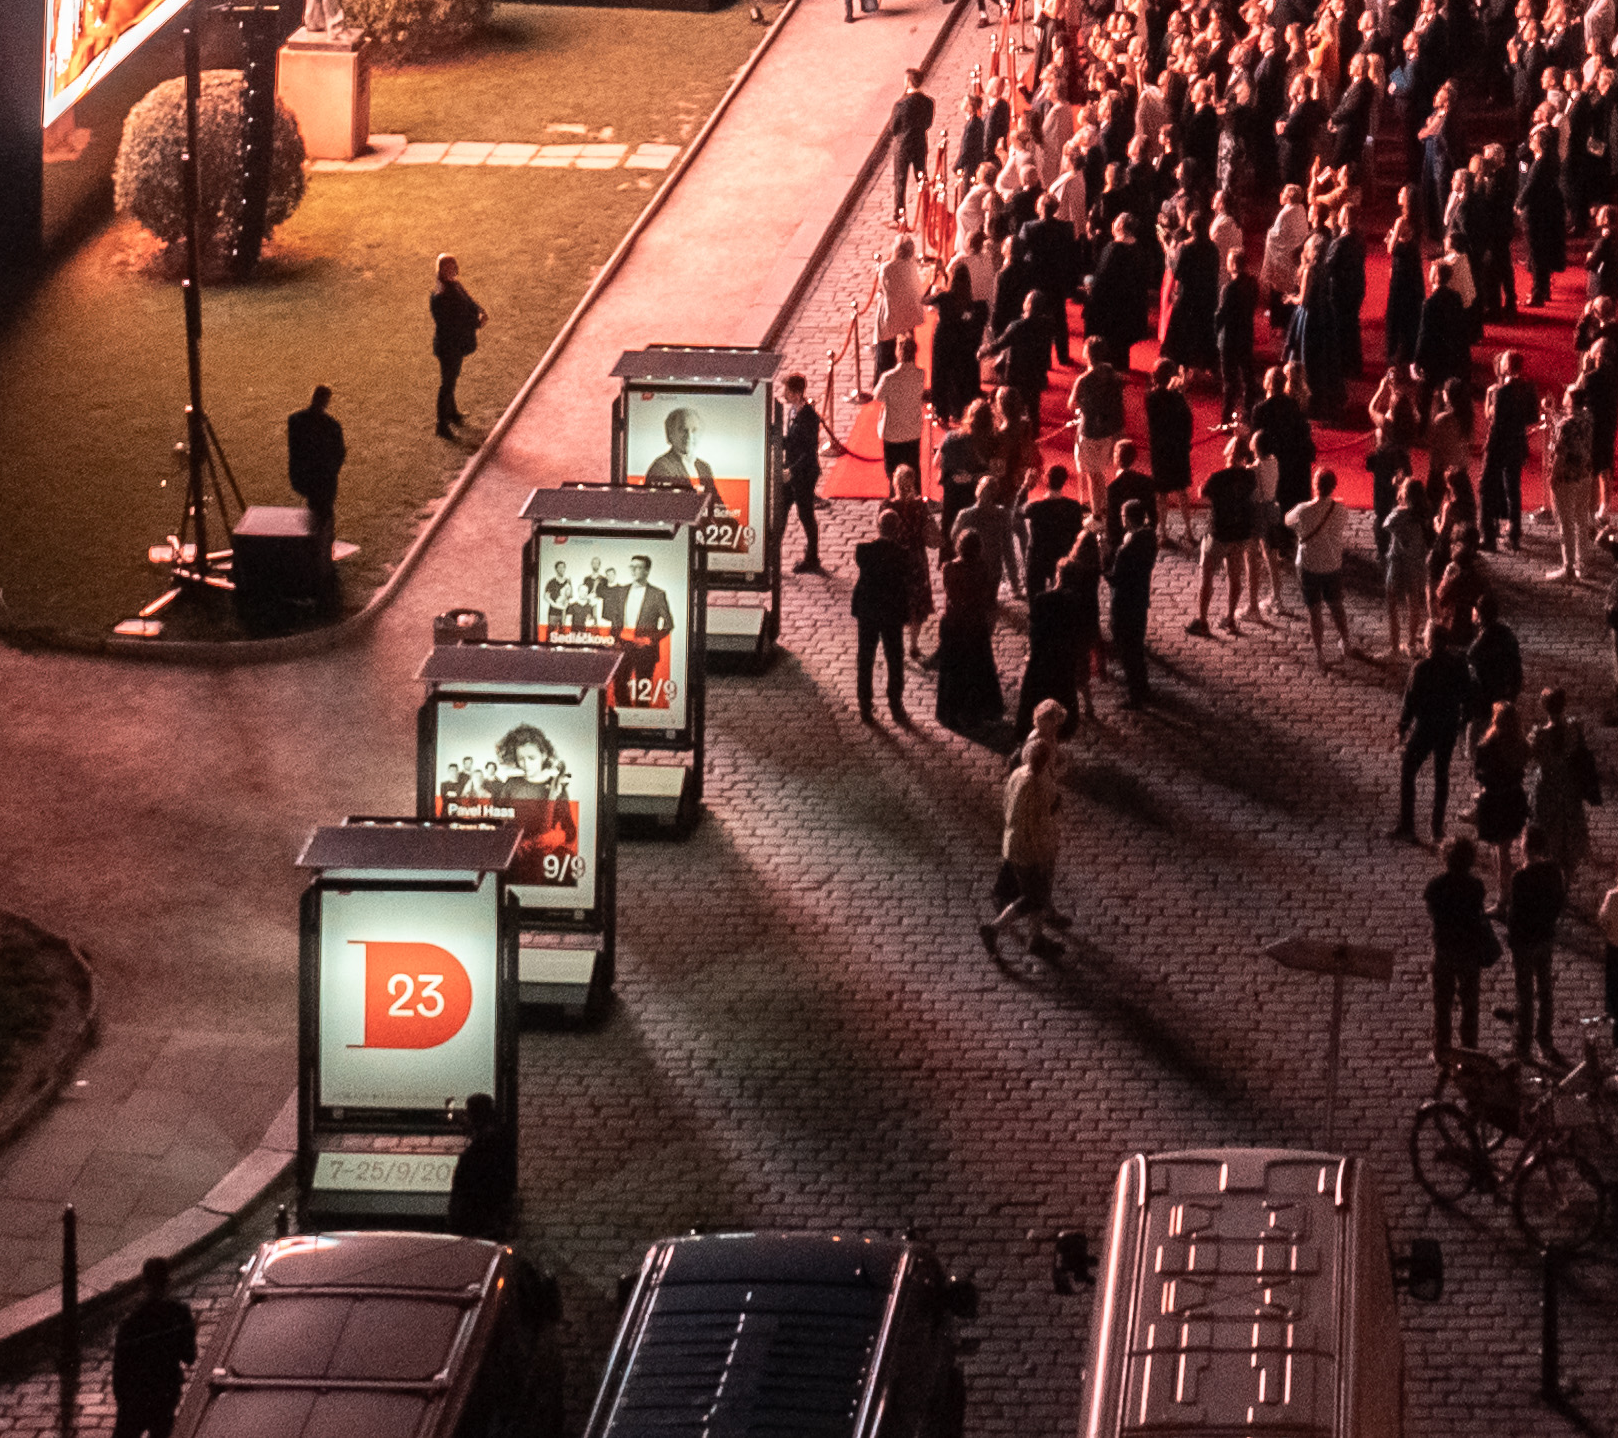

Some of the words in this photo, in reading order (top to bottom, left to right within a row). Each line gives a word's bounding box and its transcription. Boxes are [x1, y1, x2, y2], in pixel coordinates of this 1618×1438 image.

[706, 524, 757, 549] 22/9
[627, 678, 678, 704] 12/9
[447, 803, 482, 818] Pavel
[483, 804, 516, 819] Haas
[542, 854, 587, 882] 9/9
[386, 973, 445, 1018] 23
